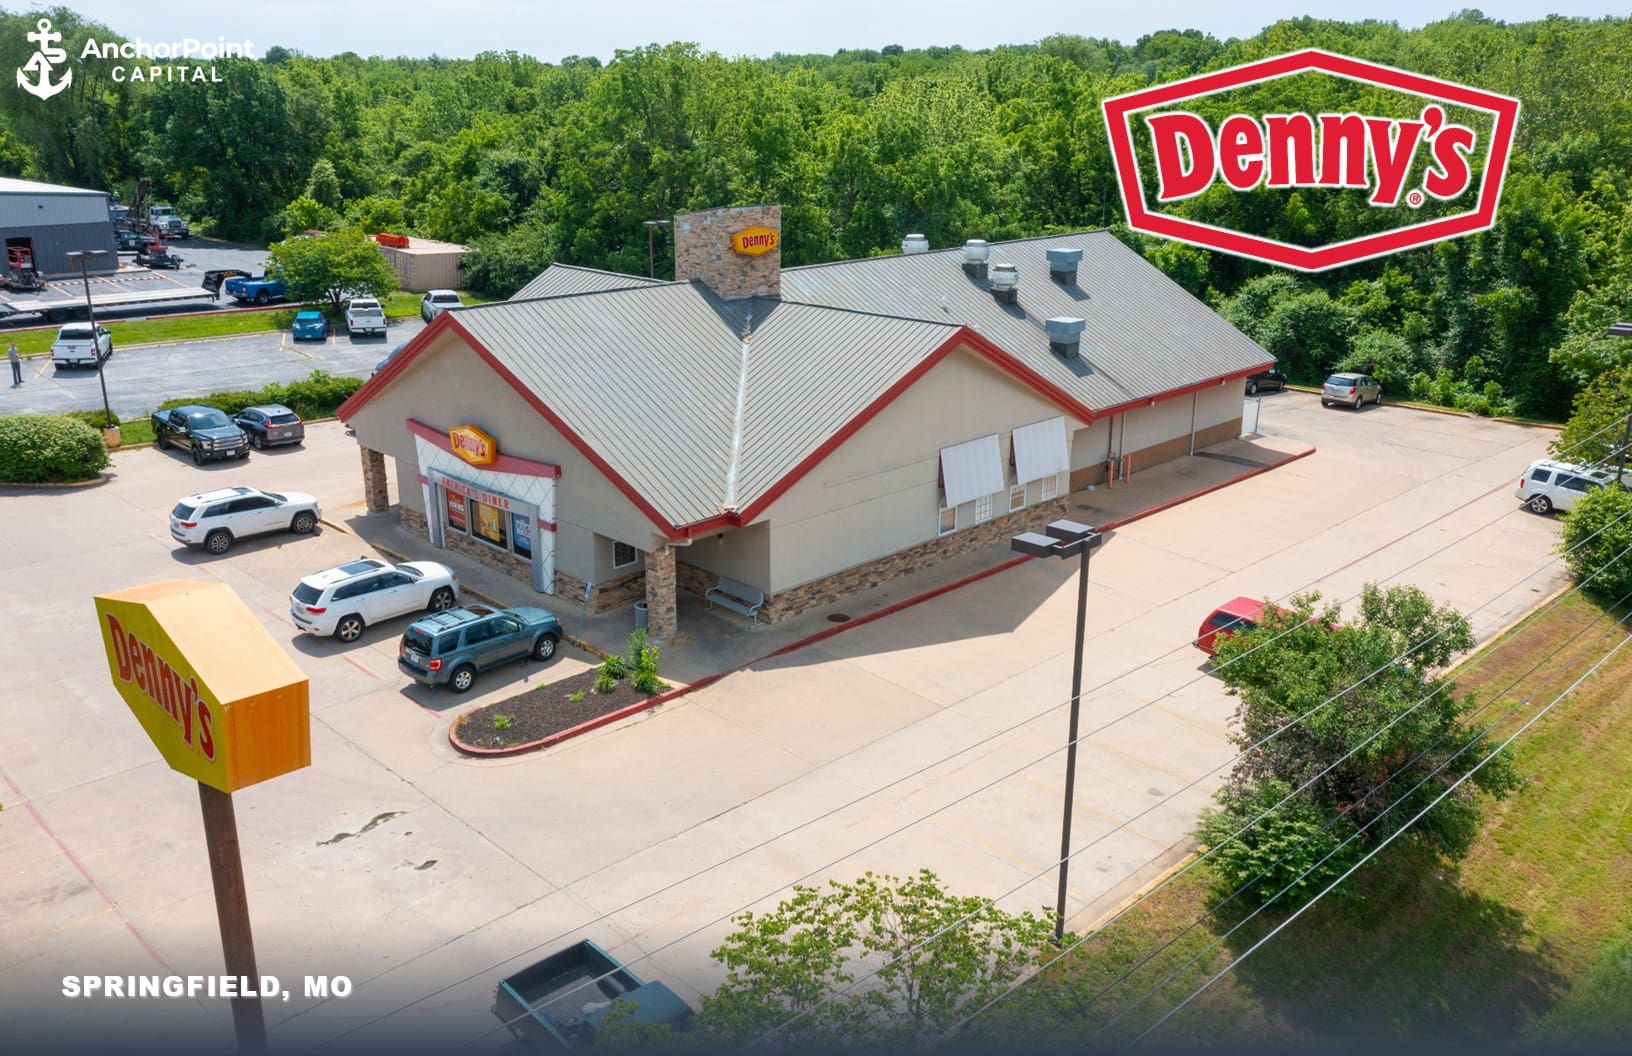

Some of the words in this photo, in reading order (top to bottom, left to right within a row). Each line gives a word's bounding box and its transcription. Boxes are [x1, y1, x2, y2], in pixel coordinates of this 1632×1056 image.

[742, 233, 775, 249] Denny's
[453, 432, 486, 457] Denny's
[442, 477, 479, 499] AMERICA'S
[482, 493, 509, 509] DINER
[106, 612, 215, 762] Denny's
